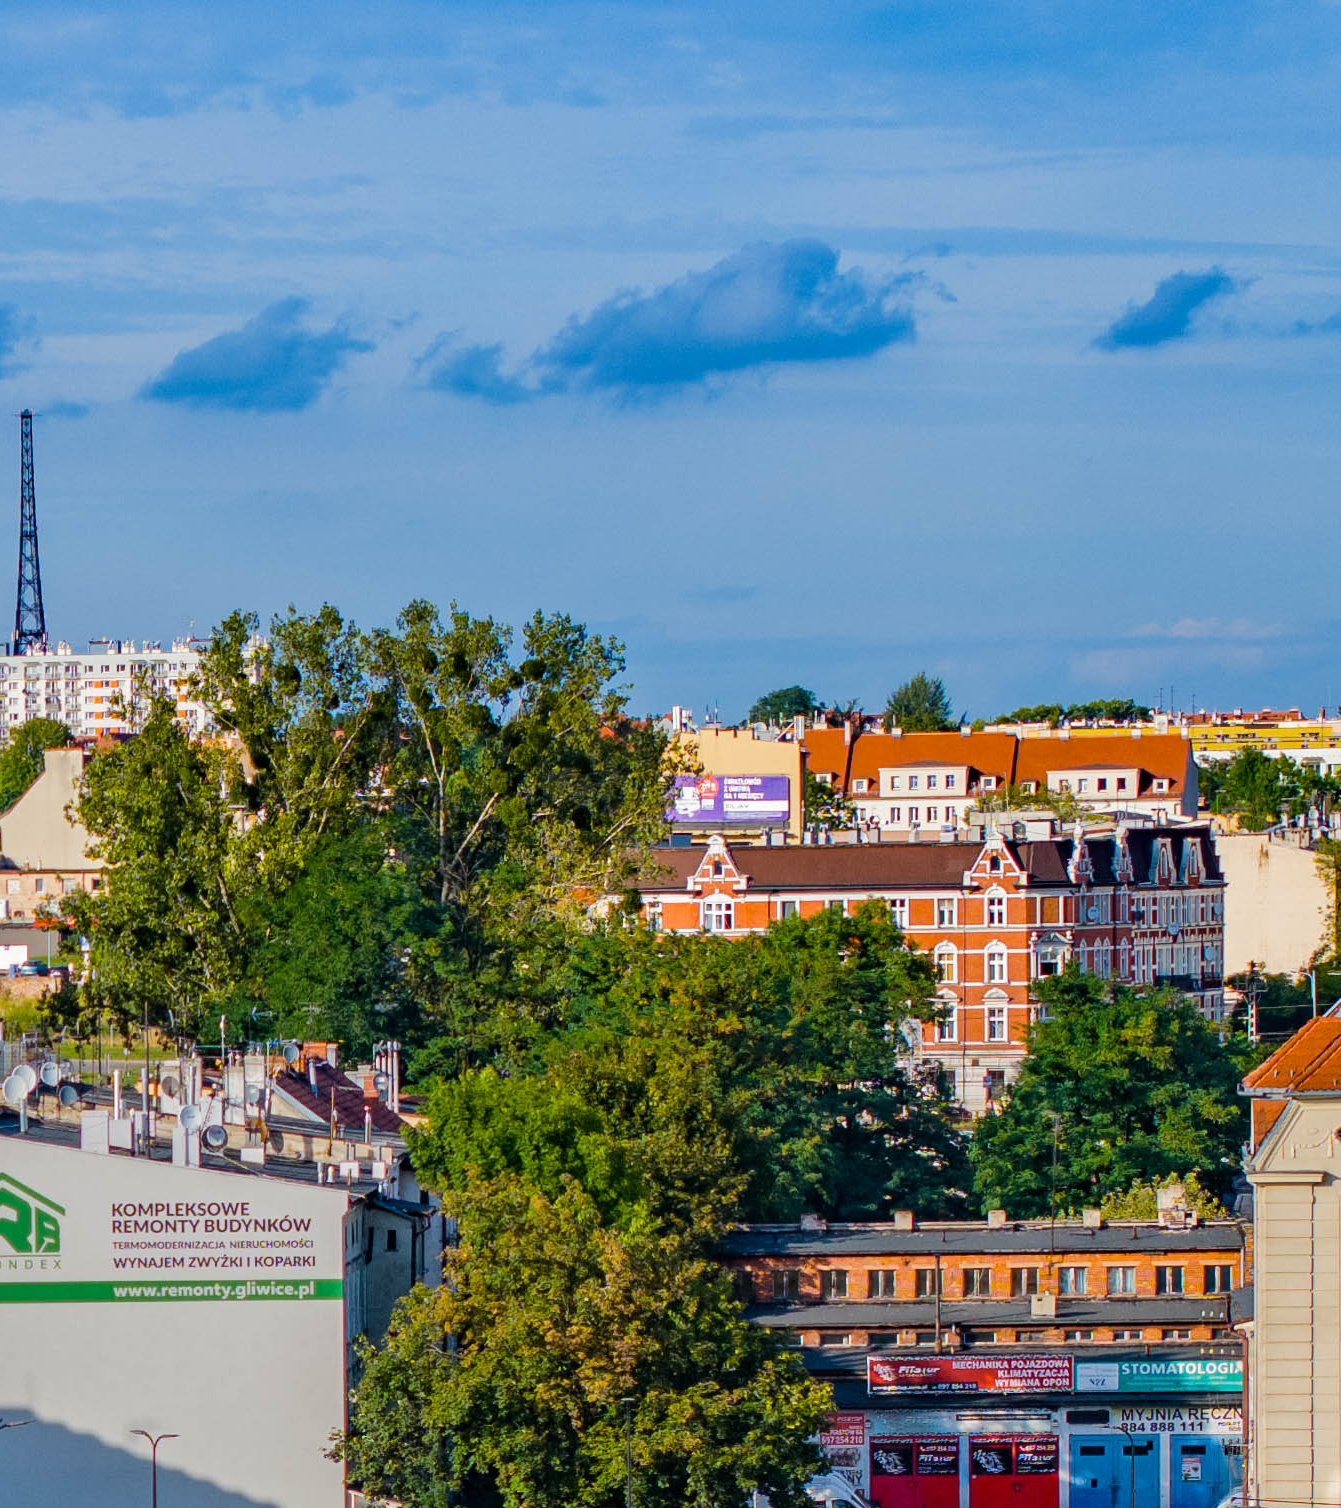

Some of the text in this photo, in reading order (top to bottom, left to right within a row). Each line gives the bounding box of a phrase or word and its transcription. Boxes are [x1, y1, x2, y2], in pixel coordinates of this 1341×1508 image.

[111, 1202, 250, 1217] KOMPLEKSOWE
[111, 1215, 312, 1234] REMONTY BUDYNKÓW
[112, 1238, 314, 1250] TERMOMODERNIZACJA NIERUCHOMOŚCI
[113, 1256, 185, 1269] WYNAJEM
[188, 1254, 243, 1268] ZWYŻKI
[254, 1256, 316, 1268] KOPARKI
[112, 1281, 315, 1299] www.remonty.gliwice.pl
[952, 1360, 1070, 1370] MECHANIKA POJAZDOWA
[1121, 1362, 1244, 1375] STOMATOLOGIA
[997, 1369, 1070, 1378] KLIMATYZACJA
[994, 1378, 1069, 1388] WYMIANA OPON
[1121, 1408, 1183, 1421] MYJNIA
[1120, 1422, 1204, 1433] 884 888 111
